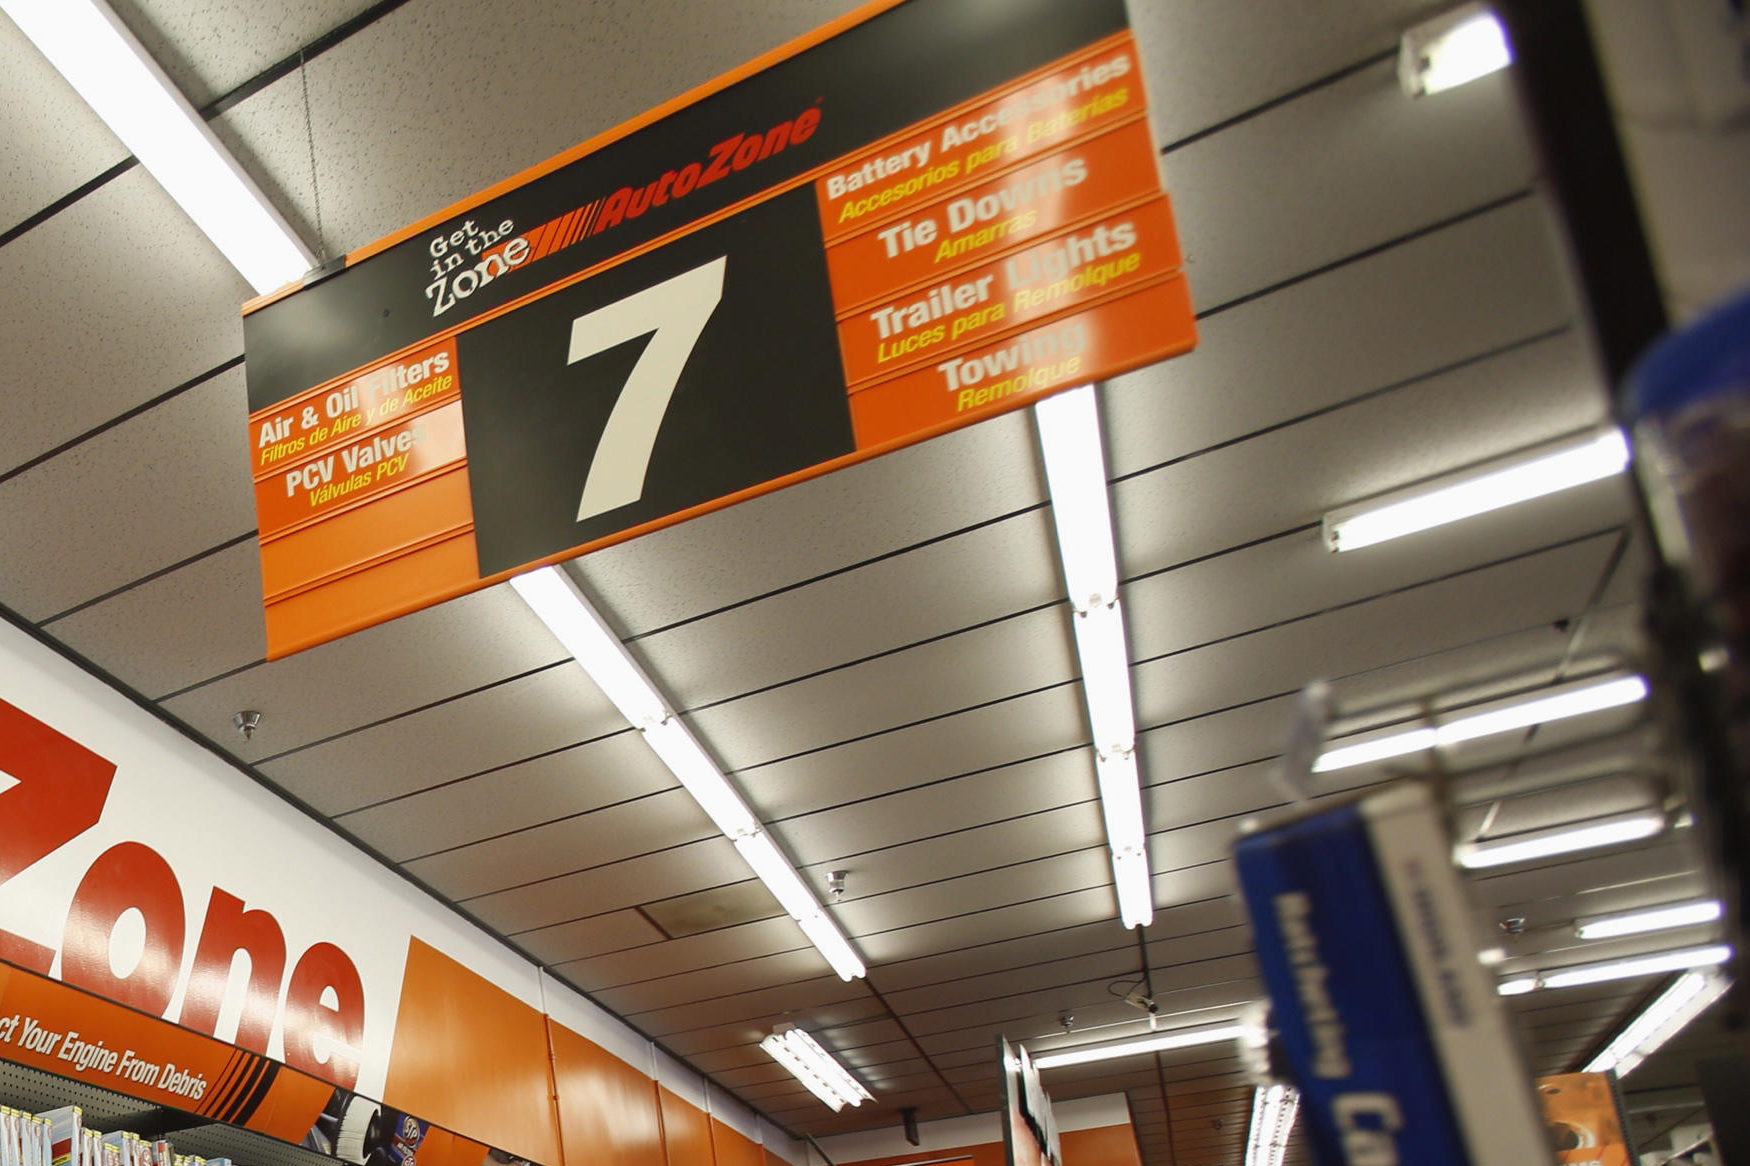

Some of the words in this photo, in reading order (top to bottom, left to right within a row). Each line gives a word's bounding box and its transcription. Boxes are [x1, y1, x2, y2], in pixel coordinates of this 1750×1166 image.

[592, 107, 821, 234] AutoZone
[827, 140, 931, 200] Battery
[941, 54, 1130, 152] Accessories
[839, 159, 959, 224] Accesorios
[966, 135, 1018, 174] para
[878, 216, 938, 259] Tie
[947, 156, 1088, 233] Downs
[425, 235, 531, 317] Zone
[429, 219, 479, 257] Get
[430, 252, 464, 281] in
[465, 218, 514, 256] the
[934, 208, 1036, 264] Amarras
[870, 274, 993, 339] Trailer
[1006, 221, 1137, 291] Lights
[878, 322, 945, 364] Luces
[952, 300, 1006, 340] para
[1013, 251, 1141, 313] Remolque
[259, 415, 293, 449] Air
[301, 406, 319, 429] &
[326, 385, 359, 418] Oil
[367, 351, 449, 400] Filters
[567, 256, 727, 522] 7
[938, 322, 1088, 392] Towing
[957, 354, 1081, 412] Remolque
[260, 435, 305, 466] Filtros
[309, 427, 328, 446] de
[331, 413, 361, 437] Aire
[365, 408, 375, 426] y
[380, 397, 398, 416] de
[402, 374, 452, 407] Aceite
[286, 455, 335, 497] PCV
[341, 424, 427, 473] Valves
[310, 471, 371, 507] Válvulas
[376, 453, 409, 481] PCV
[18, 1016, 63, 1057] Your
[57, 1029, 122, 1078] Engine
[118, 1047, 161, 1087] From
[157, 1061, 208, 1102] Debris
